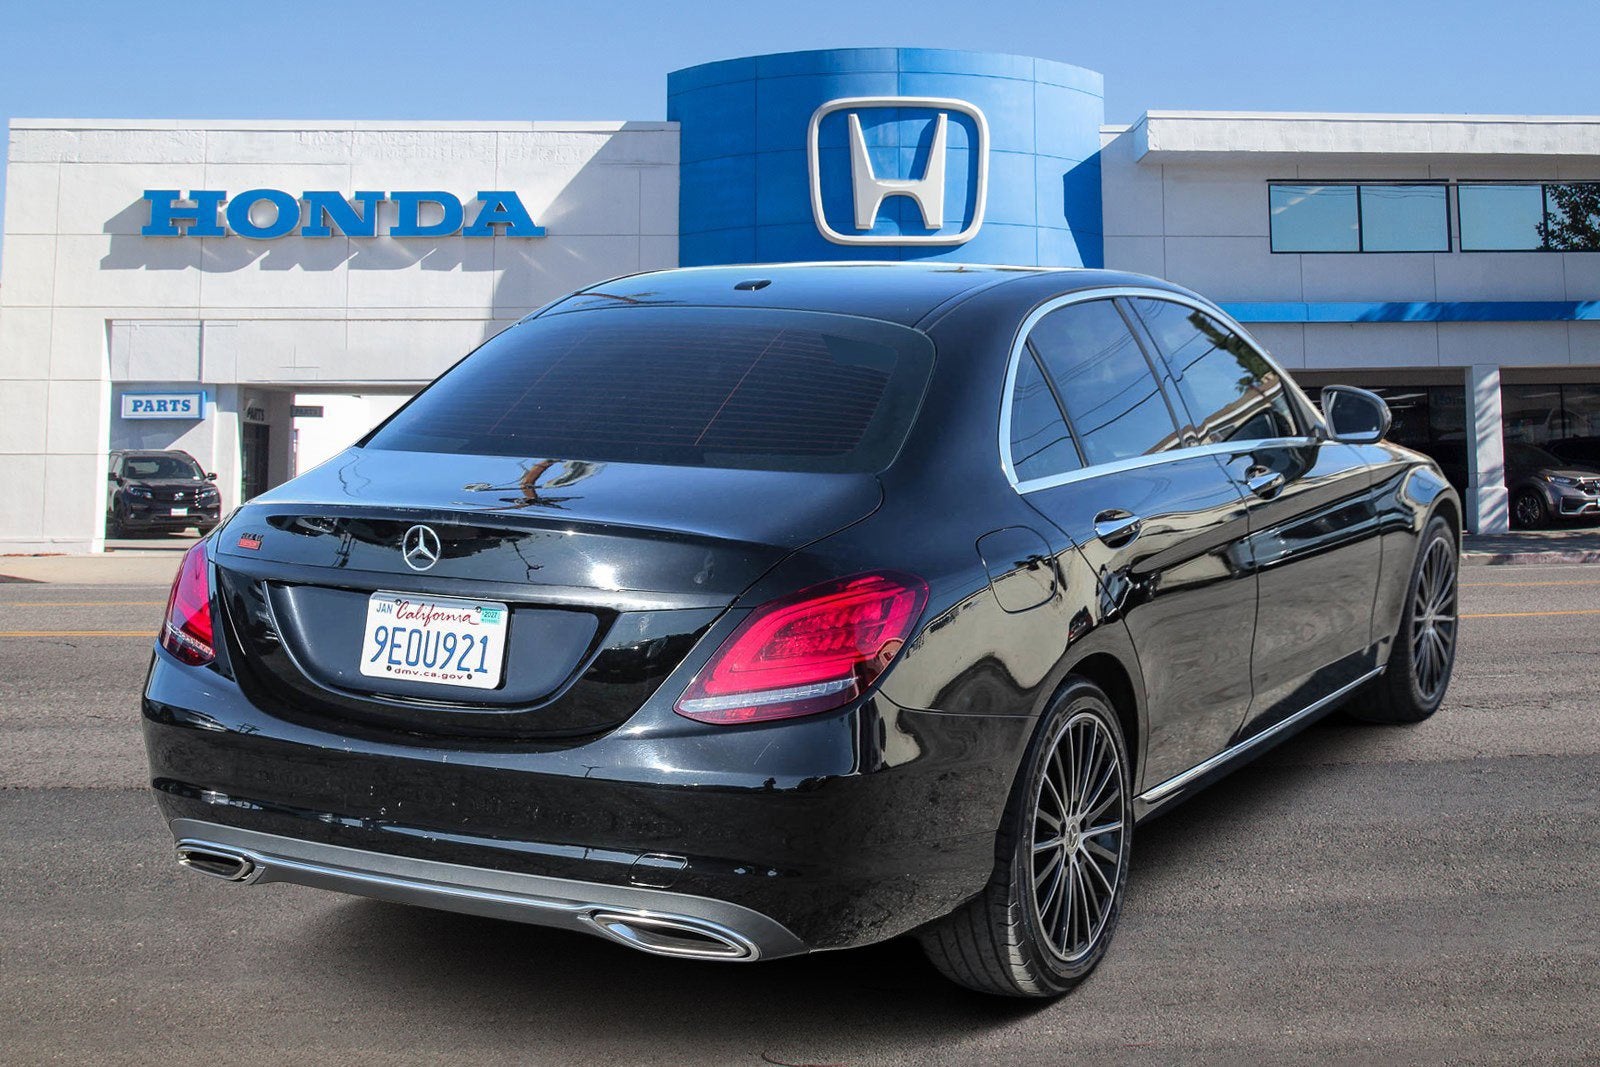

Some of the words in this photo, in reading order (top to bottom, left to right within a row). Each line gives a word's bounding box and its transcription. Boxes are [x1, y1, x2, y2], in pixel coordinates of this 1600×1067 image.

[141, 188, 547, 240] HONDA
[131, 399, 191, 412] PARTS
[376, 602, 393, 614] JAN
[396, 600, 480, 627] California
[370, 625, 488, 674] 9EOU921
[394, 668, 464, 680] dmv.ca.gov
